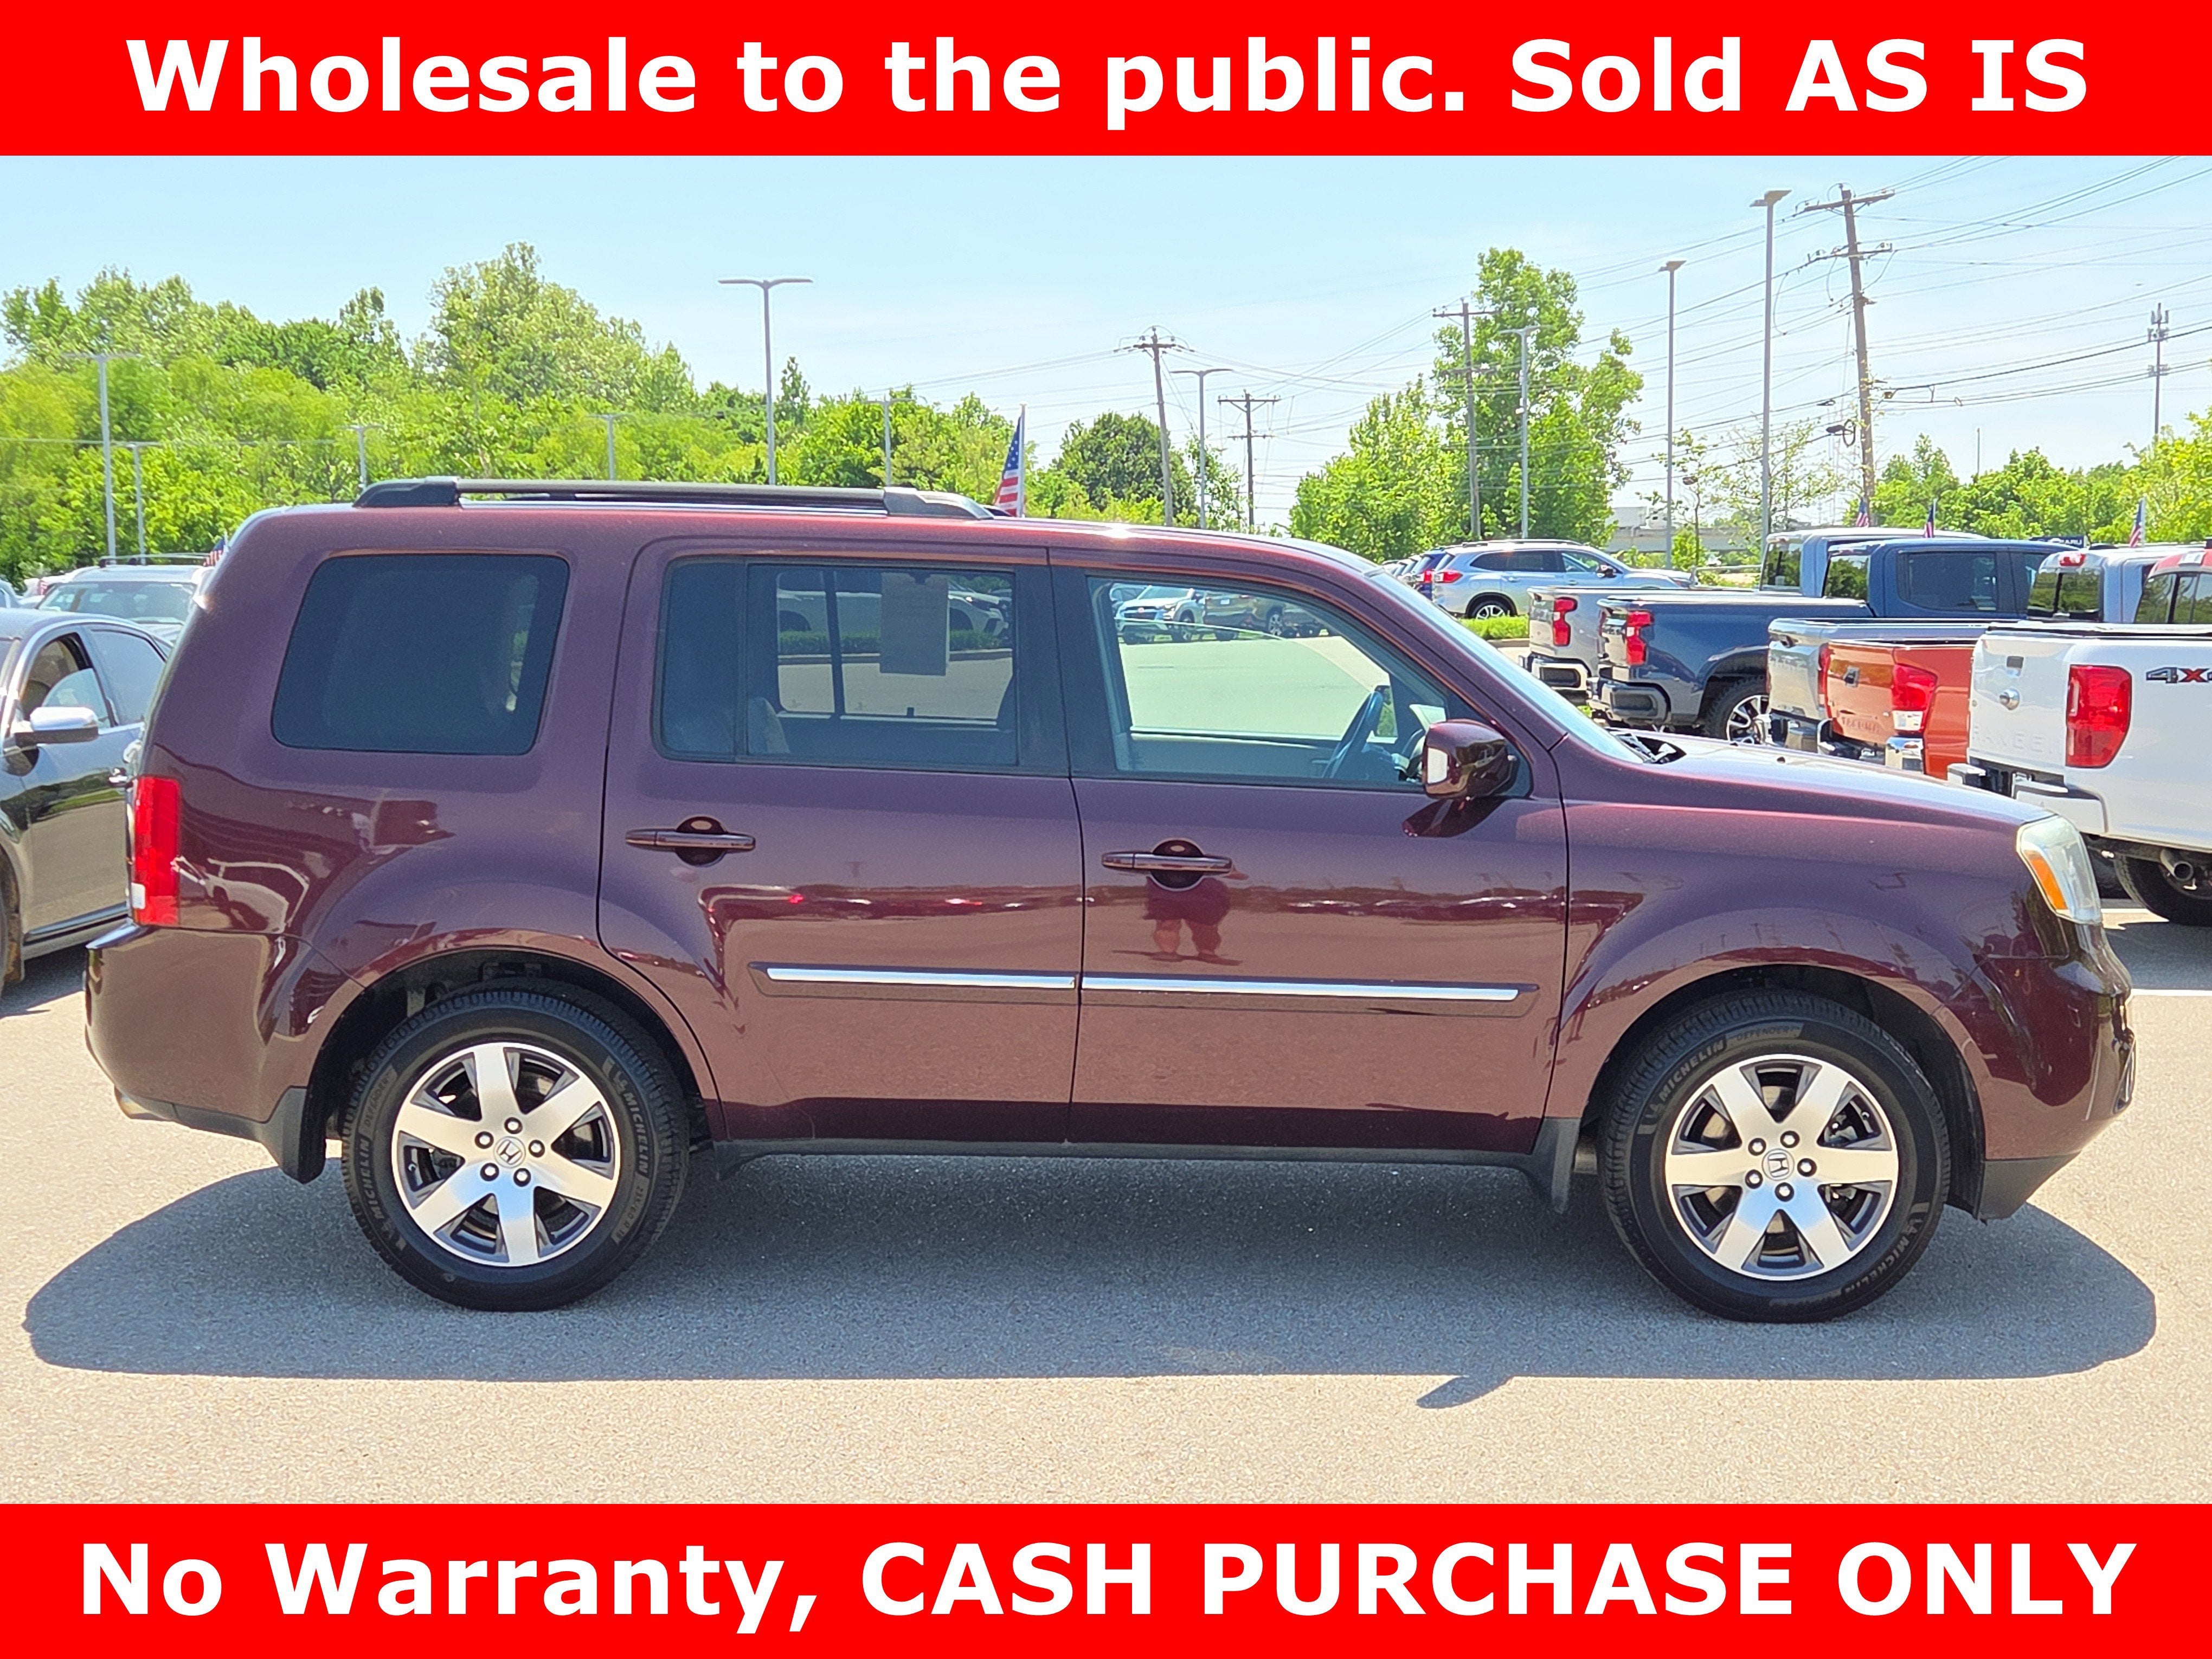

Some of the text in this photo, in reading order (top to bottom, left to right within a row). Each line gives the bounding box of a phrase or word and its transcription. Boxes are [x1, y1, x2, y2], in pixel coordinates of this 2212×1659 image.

[1658, 1039, 1724, 1102] MICHELIN
[623, 1092, 649, 1174] MICHELIN
[359, 1138, 385, 1220] MICHELIN
[1845, 1236, 1910, 1294] MICHELIN
